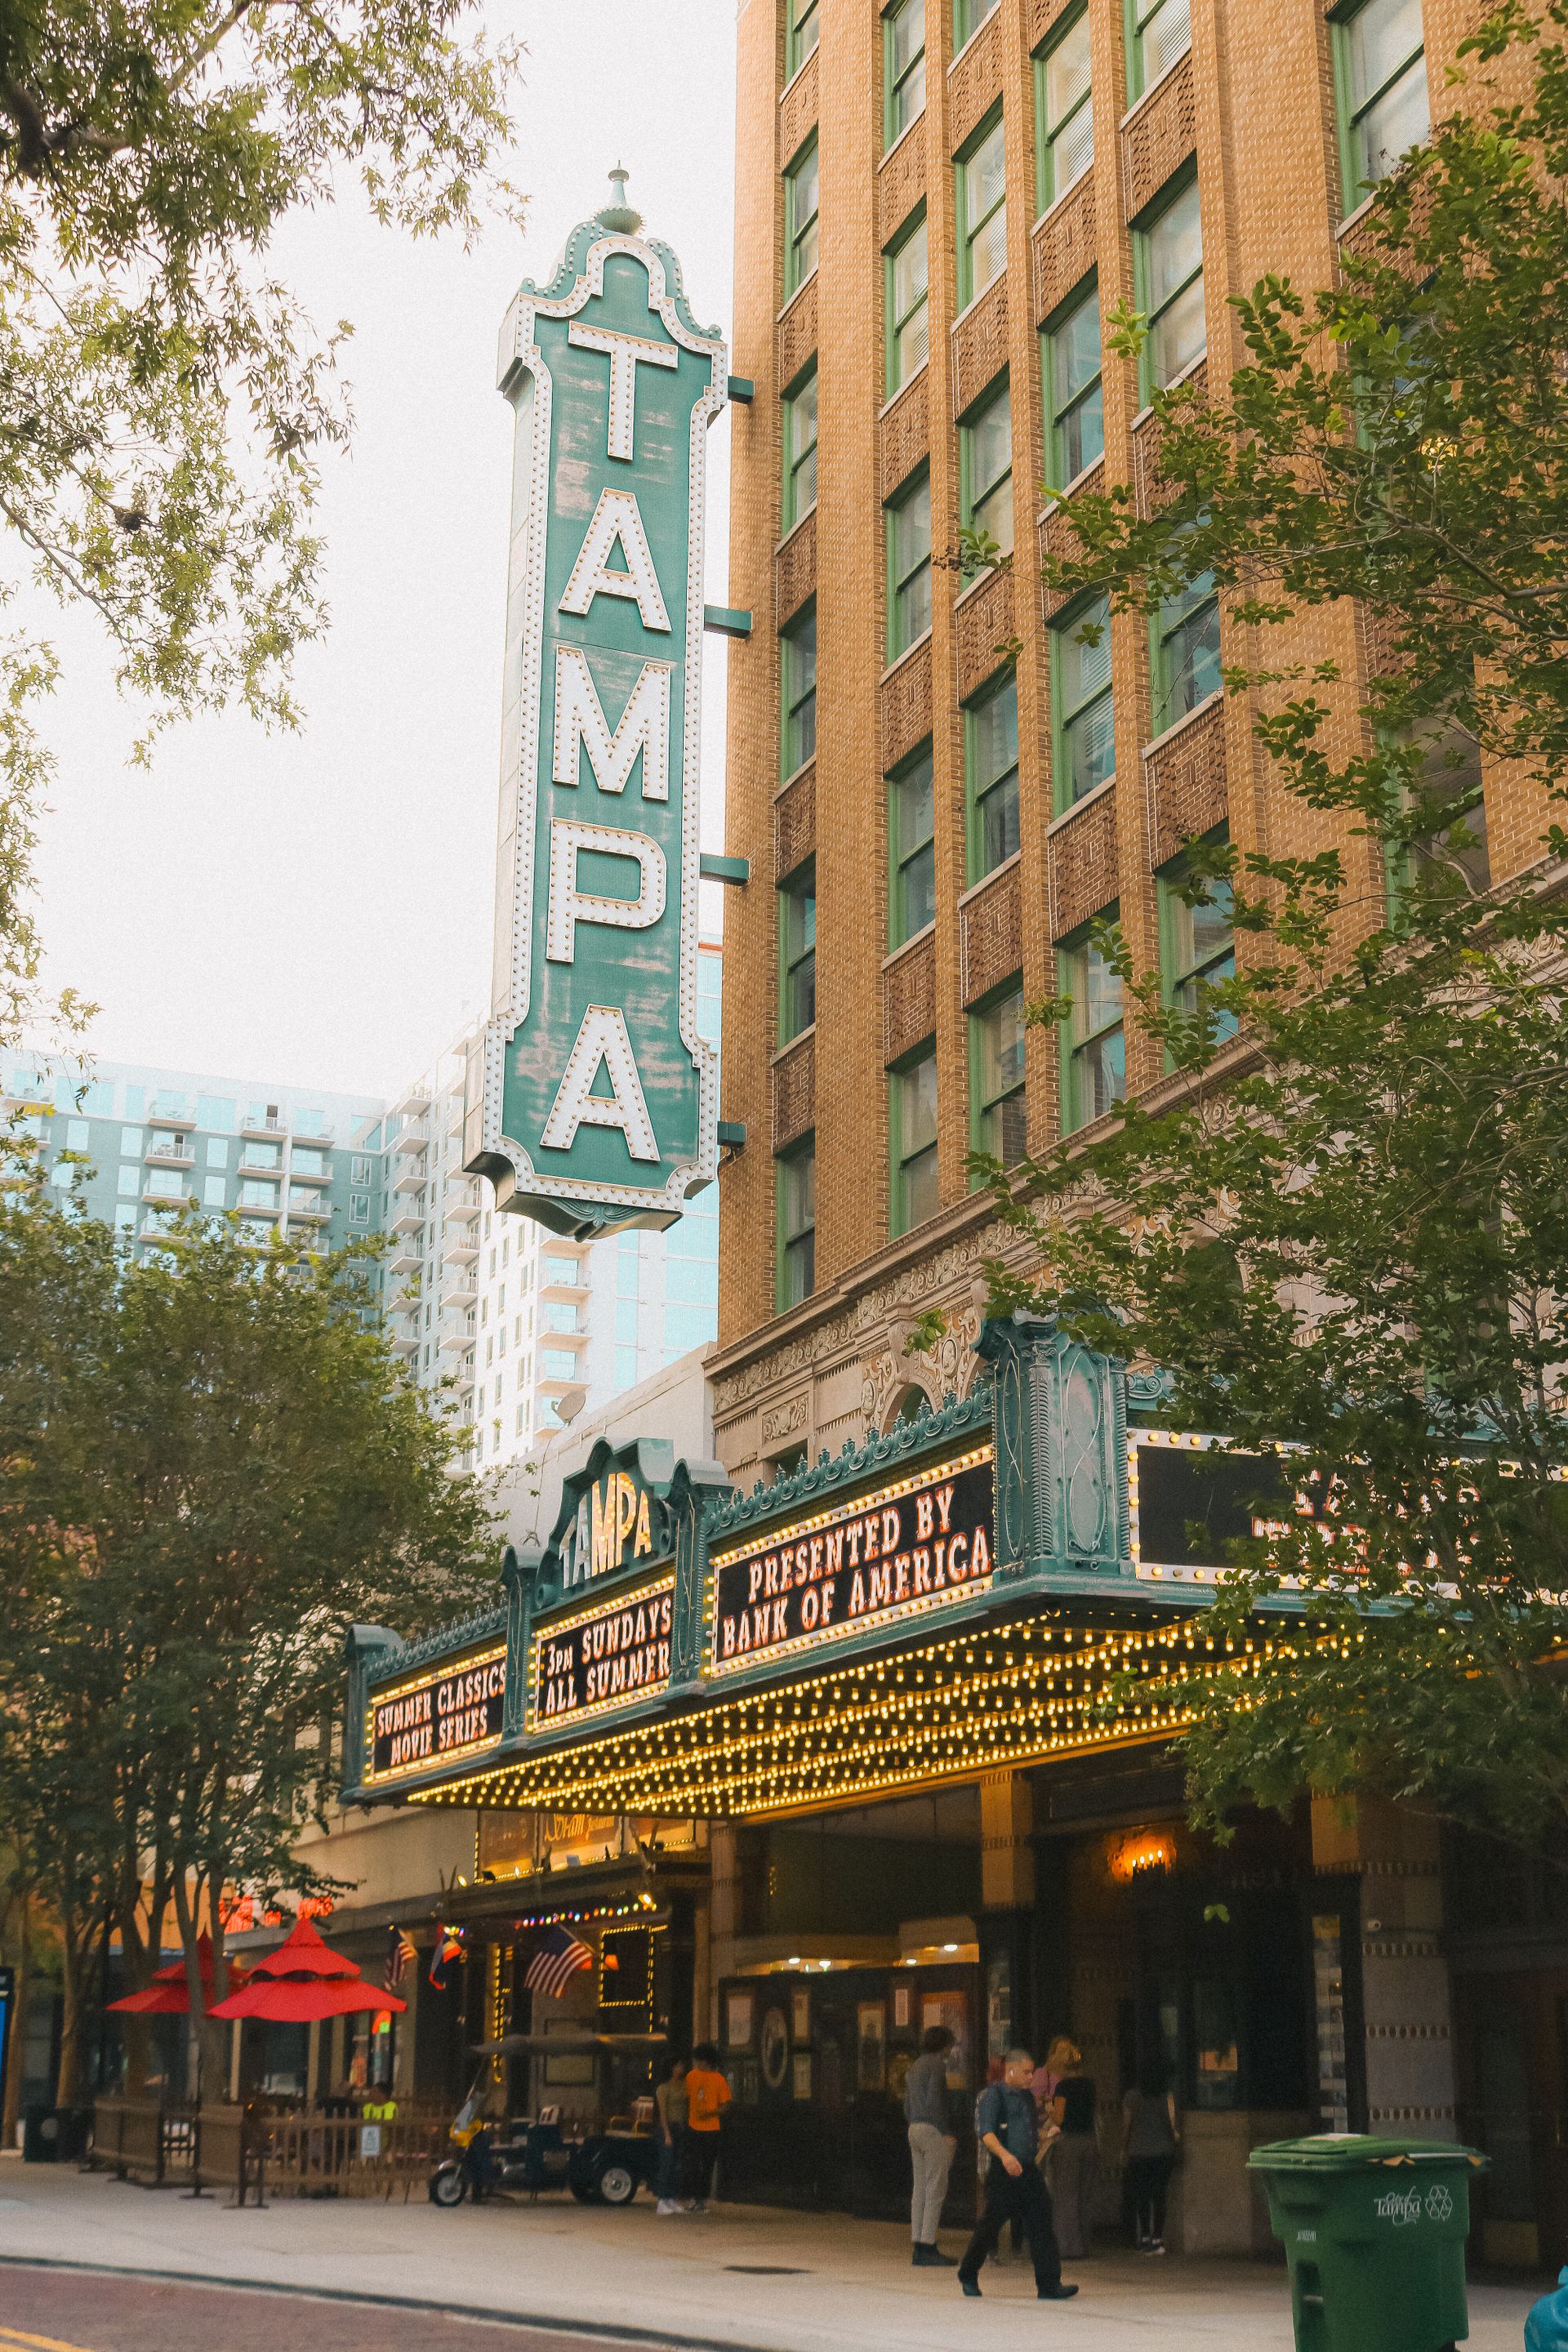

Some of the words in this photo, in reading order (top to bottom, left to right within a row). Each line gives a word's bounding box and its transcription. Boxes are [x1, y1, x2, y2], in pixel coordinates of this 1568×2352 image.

[539, 319, 679, 1161] TAMPA
[559, 1472, 653, 1589] TAMPA
[748, 1506, 902, 1605] PRESENTED
[915, 1481, 955, 1542] BY
[581, 1594, 671, 1664] SUNDAYS
[722, 1595, 789, 1659] BANK
[800, 1579, 835, 1632] OF
[848, 1525, 991, 1617] AMERICA
[377, 1690, 432, 1739] SUMMER
[437, 1661, 506, 1716] CLASSICS
[545, 1674, 577, 1718] ALL
[586, 1638, 670, 1703] SUMMER
[390, 1723, 434, 1766] MOVIE
[437, 1703, 488, 1751] SERIES
[1374, 2197, 1421, 2220] Tampa
